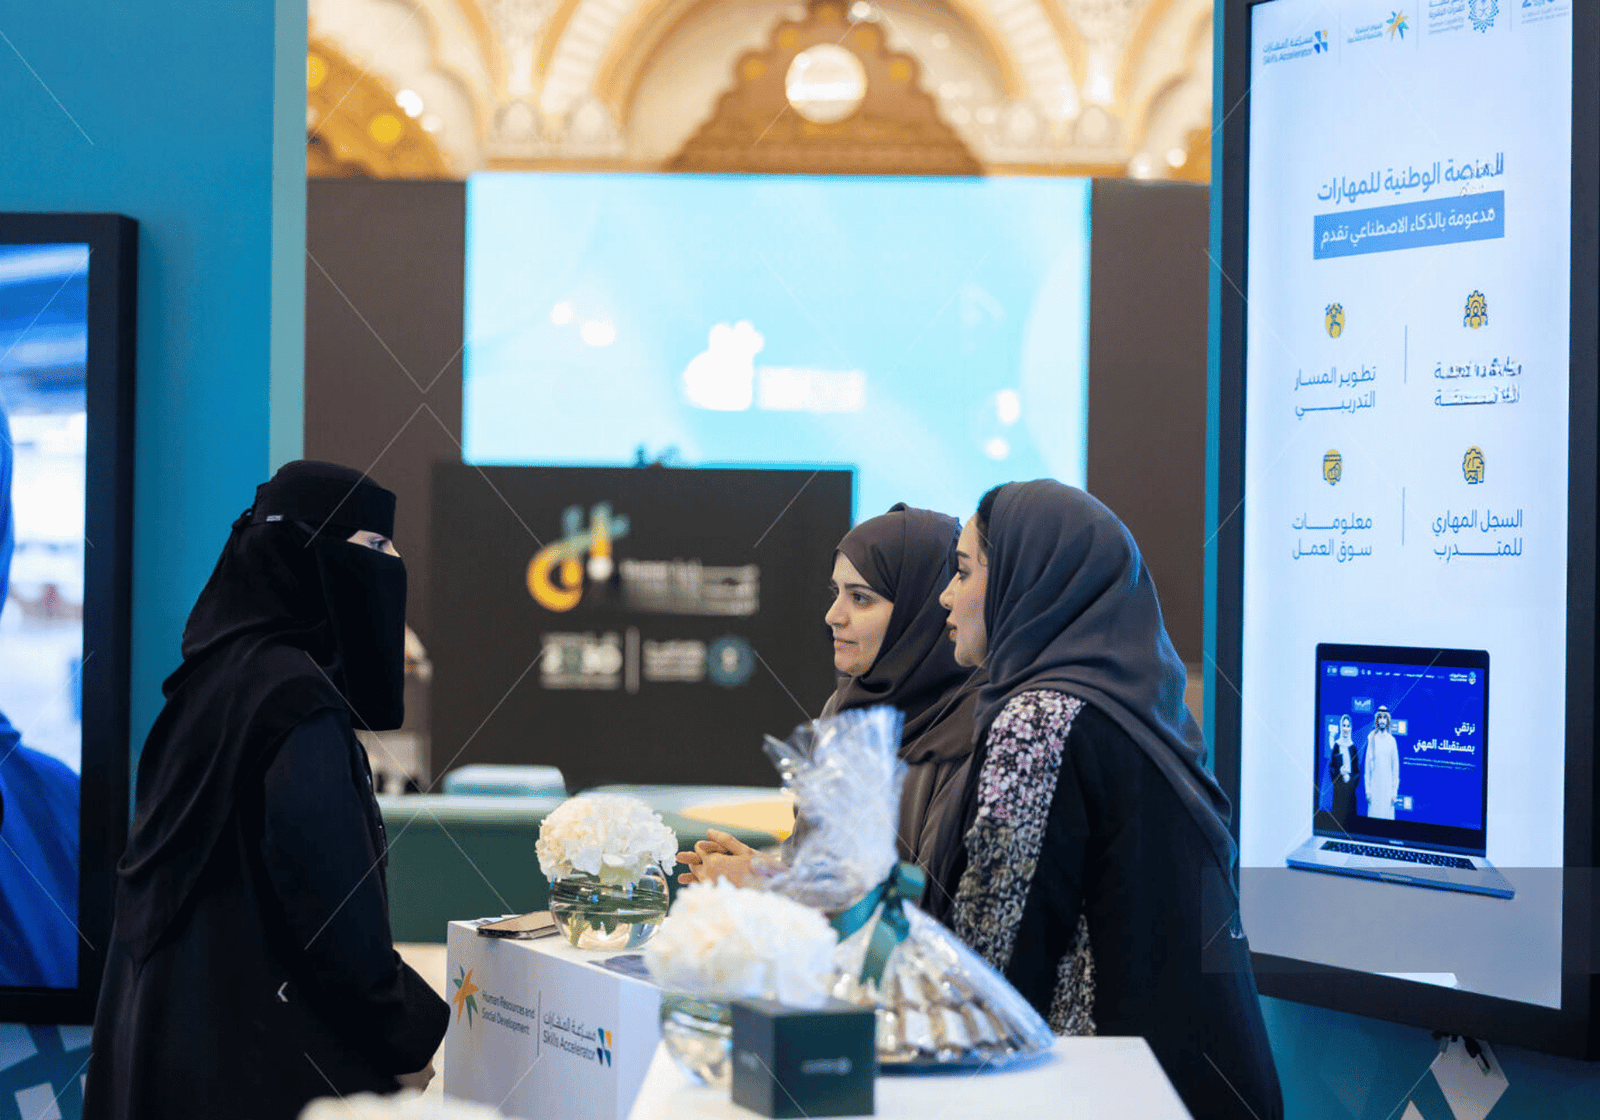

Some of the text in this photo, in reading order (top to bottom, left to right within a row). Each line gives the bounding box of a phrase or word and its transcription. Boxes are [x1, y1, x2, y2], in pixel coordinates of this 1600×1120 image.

[1317, 170, 1380, 204] للمهارات
[1384, 161, 1440, 195] الوطنية
[1320, 208, 1496, 249] مدعومة بالذكاء الاصطناعي تقدم
[1294, 364, 1376, 392] تطوير المسار
[1295, 390, 1376, 421] التدريبي
[1292, 512, 1372, 535] معلومات
[1432, 509, 1523, 536] السجل المهاري
[1292, 539, 1372, 563] سوق العمل
[1433, 537, 1523, 562] للمتدرب
[1454, 722, 1475, 736] نرتقي
[482, 990, 499, 1006] Human
[500, 996, 525, 1015] Resources
[482, 1007, 530, 1035] Social Development
[542, 1030, 595, 1060] Skills Accelerator
